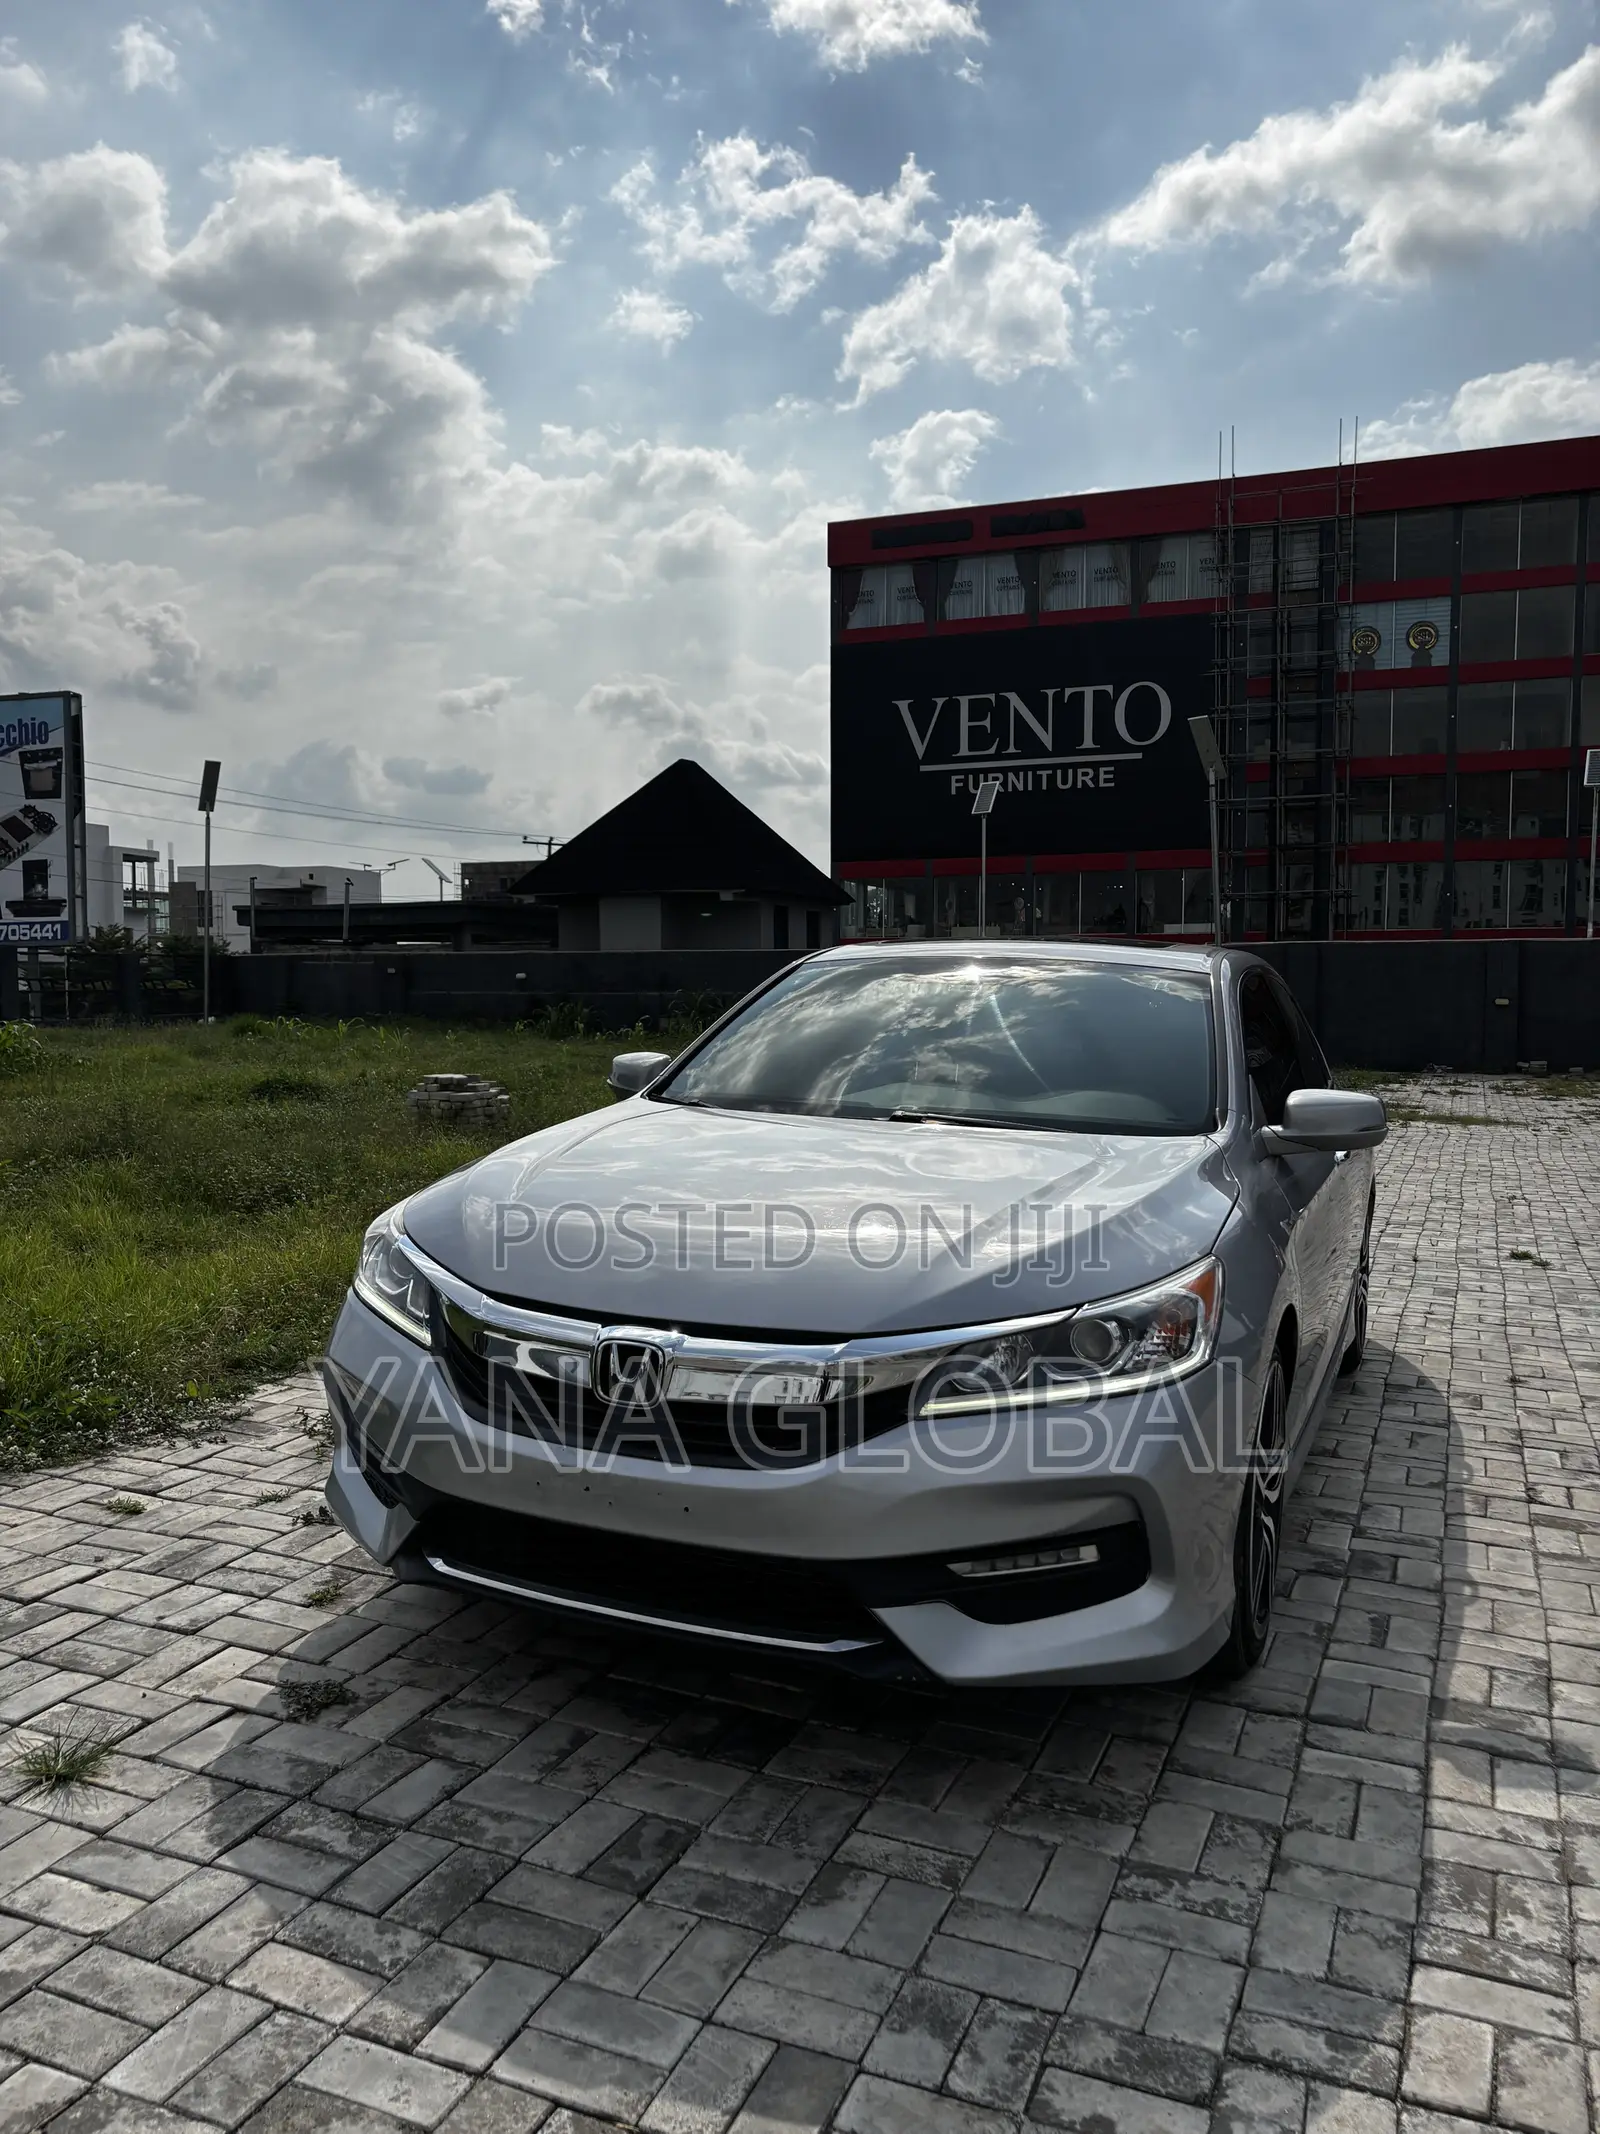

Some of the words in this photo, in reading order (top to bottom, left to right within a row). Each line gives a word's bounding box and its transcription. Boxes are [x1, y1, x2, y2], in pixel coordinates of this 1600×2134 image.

[1052, 569, 1077, 579] VENTO
[1093, 566, 1119, 575] VENTO
[997, 575, 1021, 584] VENTO
[892, 681, 1171, 760] VENTO
[951, 766, 1115, 795] FURNITURE
[0, 923, 61, 941] 705441
